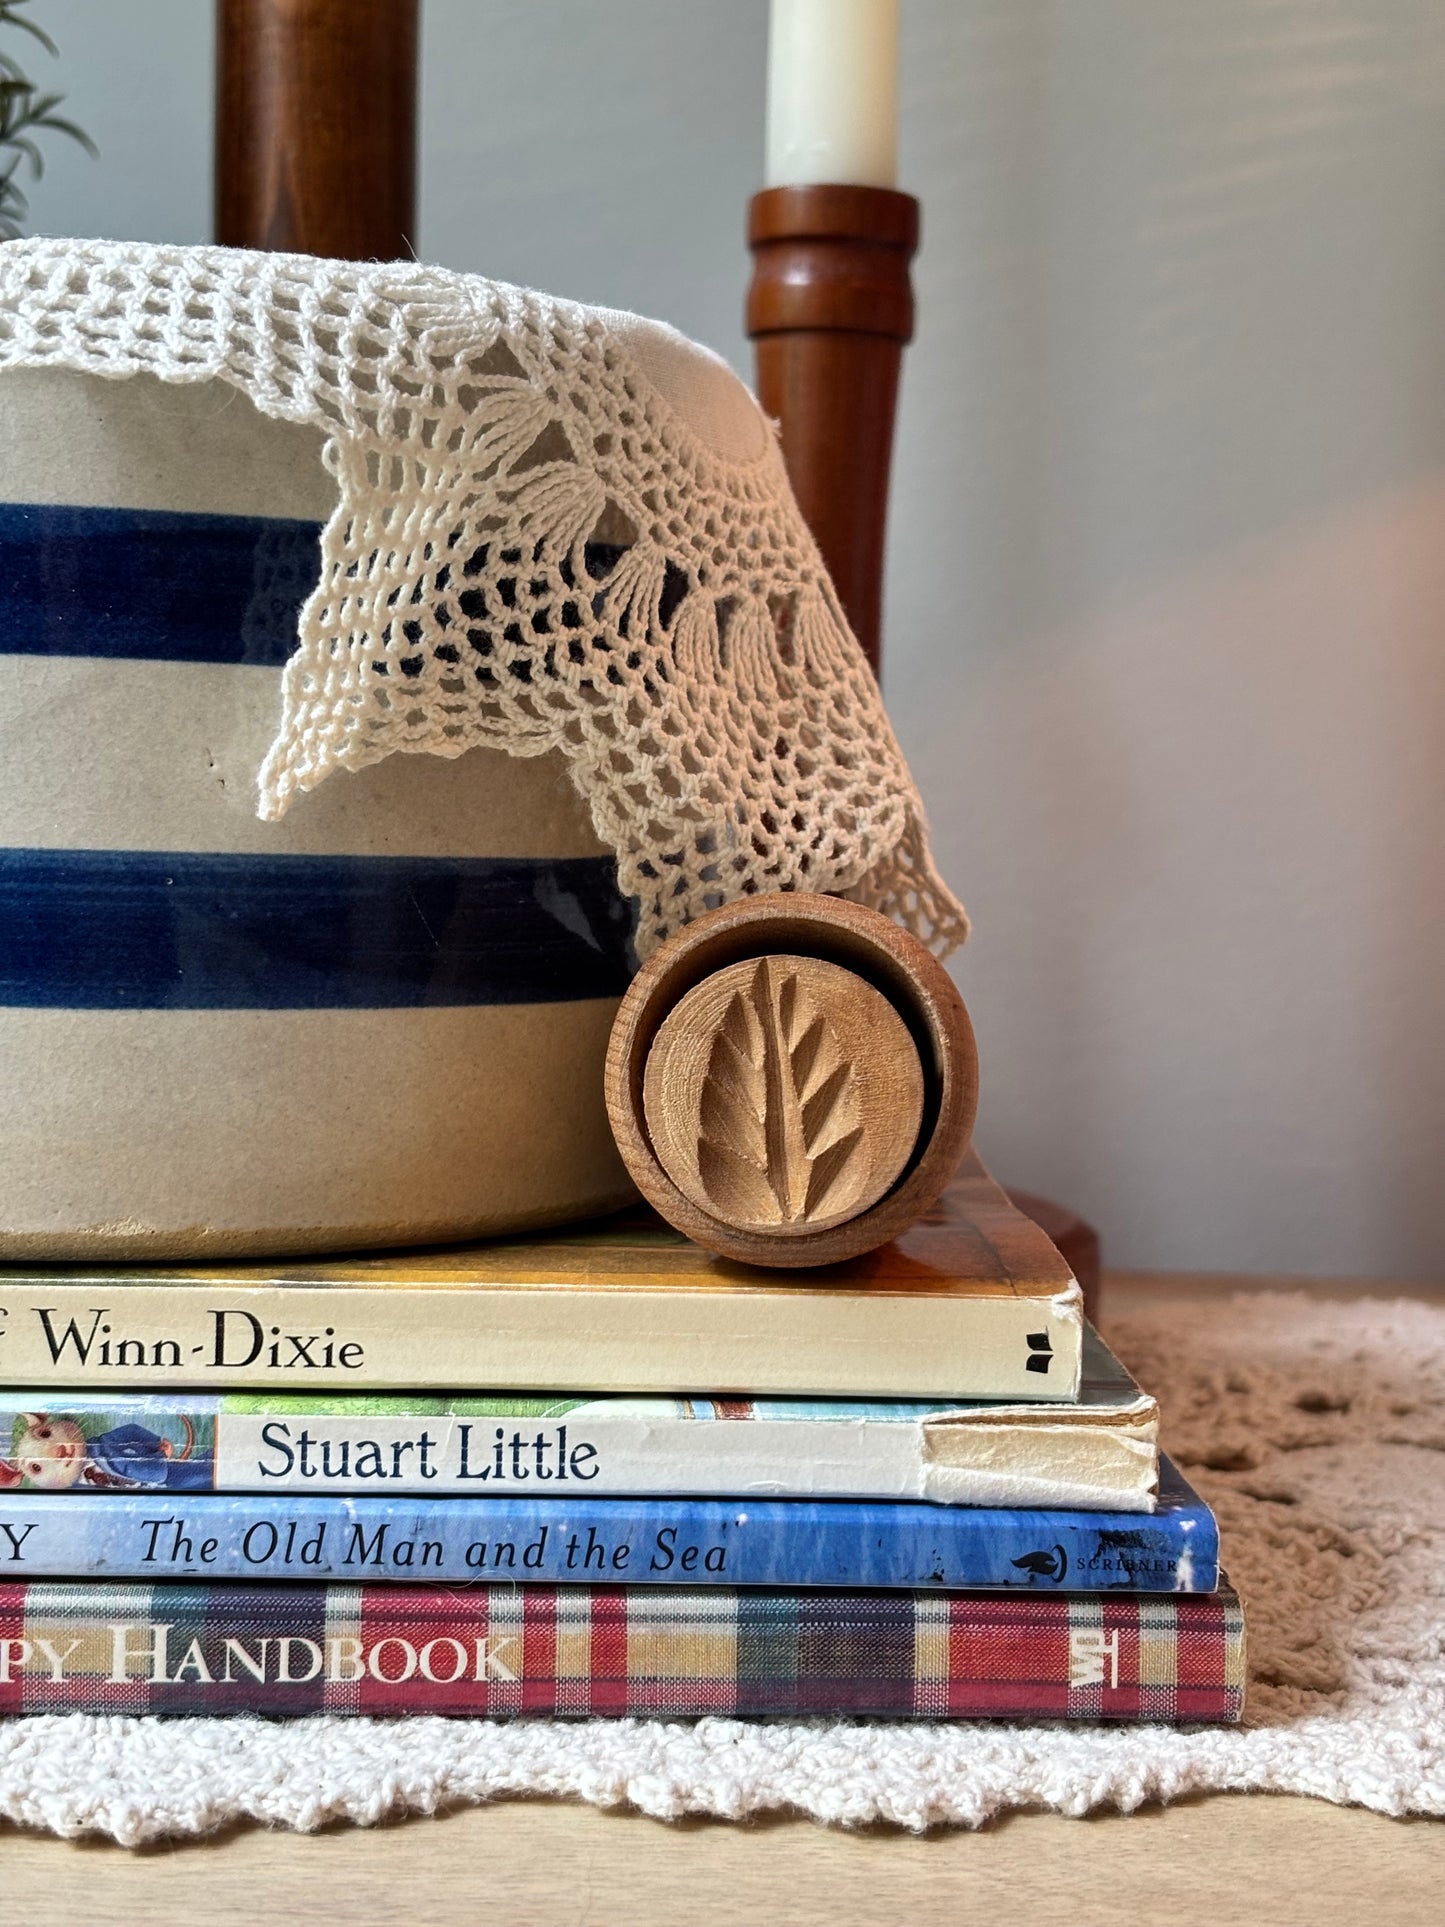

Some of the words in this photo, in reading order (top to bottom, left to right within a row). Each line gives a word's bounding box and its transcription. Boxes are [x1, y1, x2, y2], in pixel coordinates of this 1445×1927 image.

[31, 1308, 364, 1369] Winn-Dixie
[258, 1422, 438, 1479] Stuart
[455, 1424, 600, 1480] Little
[0, 1523, 39, 1560] Y
[140, 1517, 219, 1563] The
[242, 1521, 326, 1565] Old
[343, 1522, 443, 1566] Man
[464, 1526, 548, 1570] and
[566, 1527, 630, 1570] the
[649, 1527, 727, 1573] Sea
[1076, 1557, 1177, 1573] SCRIBNER
[104, 1622, 520, 1685] HANDBOOK
